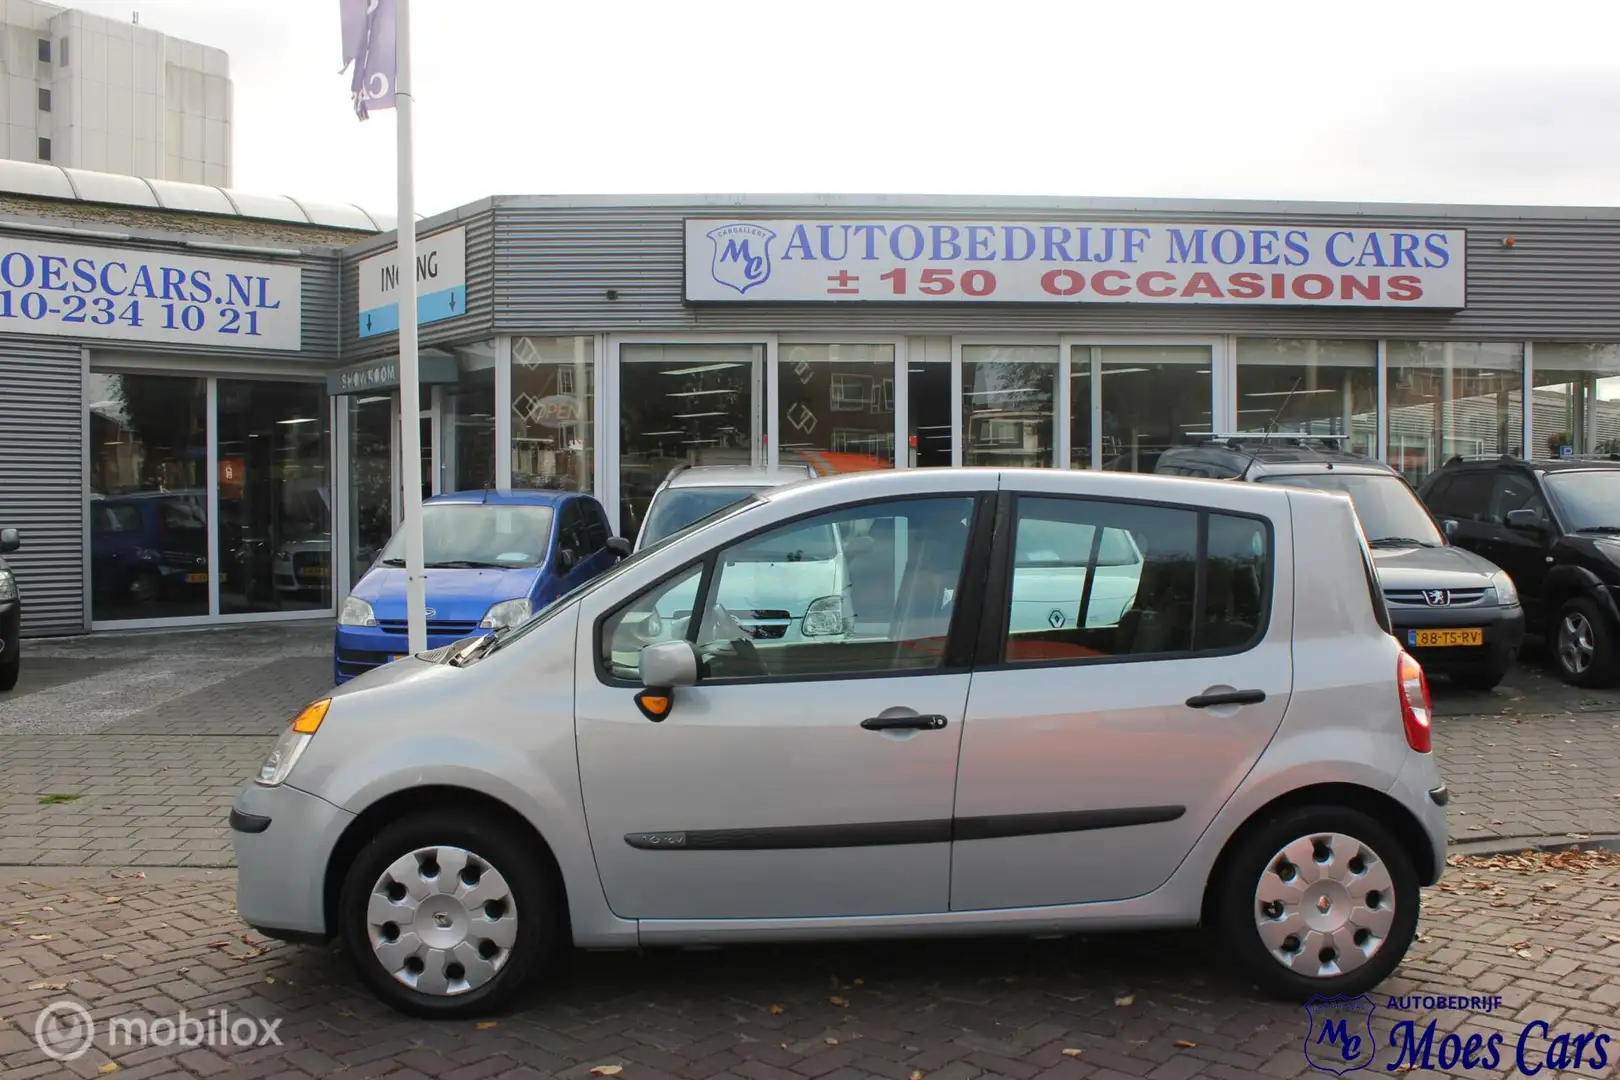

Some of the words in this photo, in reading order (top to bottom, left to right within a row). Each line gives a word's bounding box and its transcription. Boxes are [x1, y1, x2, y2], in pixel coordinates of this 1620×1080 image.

[780, 224, 1150, 263] AUTOBEDRIJF
[1165, 228, 1311, 266] MOES
[1325, 231, 1450, 268] CARS
[1, 252, 281, 309] OESCARS.NL
[380, 250, 438, 293] INNG
[879, 267, 997, 296] 150
[1040, 269, 1424, 301] OCCASIONS
[161, 304, 205, 331] 10
[218, 308, 263, 336] 21
[341, 365, 395, 389] SHOWROOM
[1420, 632, 1478, 645] 88-TS-RV
